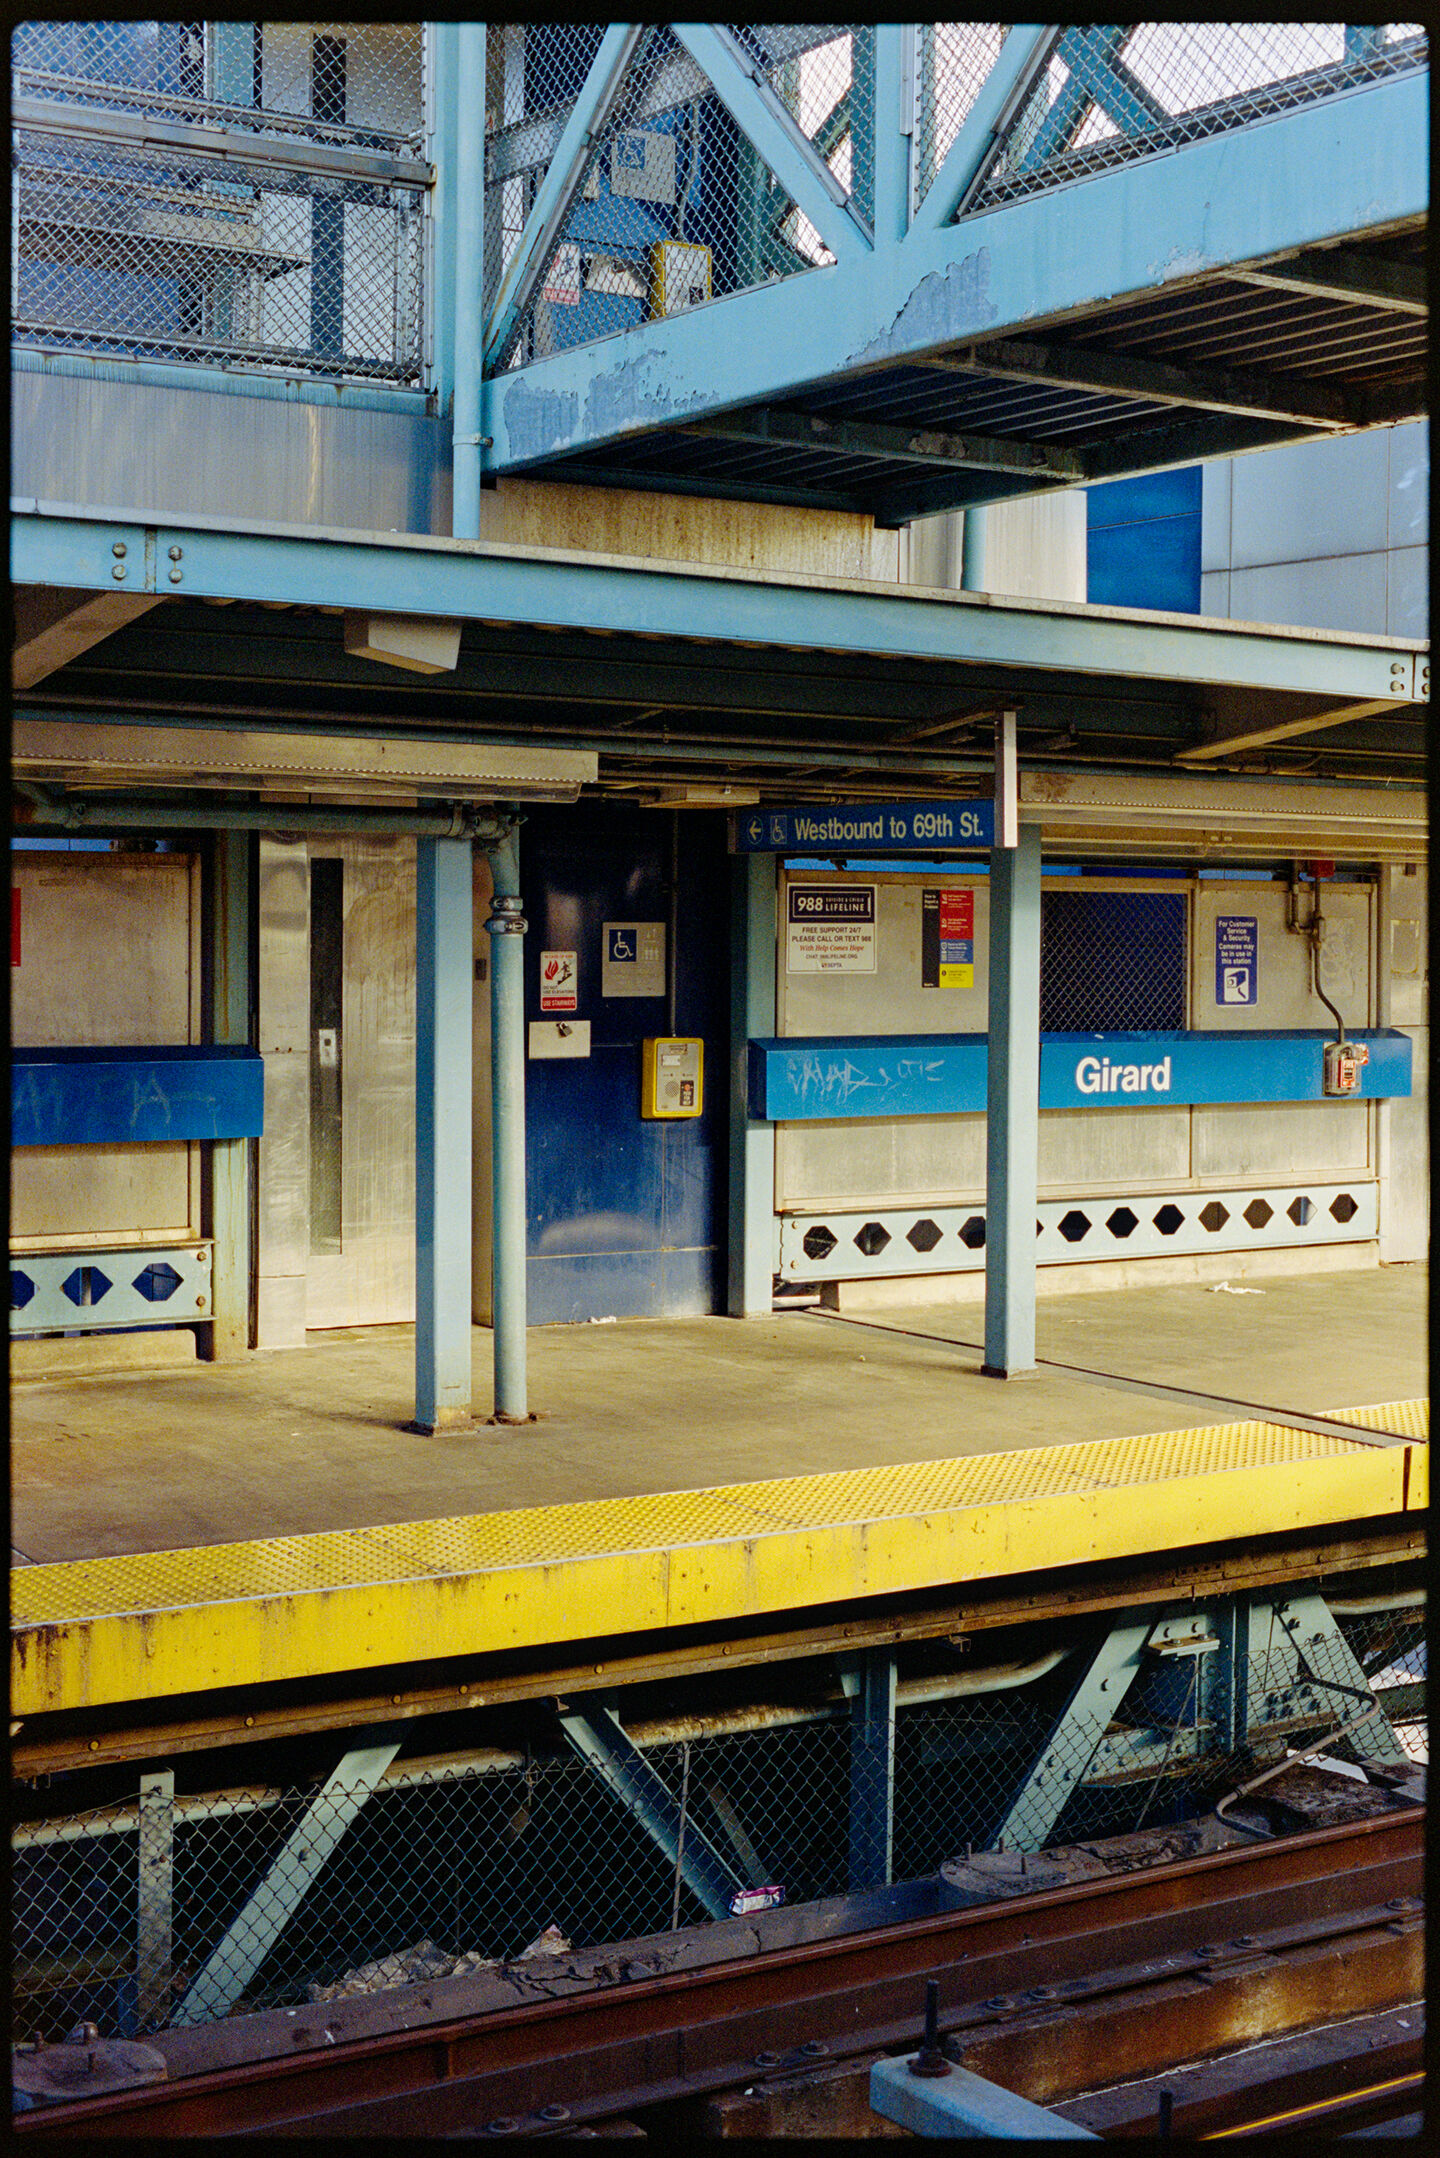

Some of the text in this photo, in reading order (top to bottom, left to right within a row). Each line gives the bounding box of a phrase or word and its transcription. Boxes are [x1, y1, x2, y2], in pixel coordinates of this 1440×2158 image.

[794, 811, 984, 841] Westbound to 69th St.
[797, 897, 823, 912] 988
[825, 903, 865, 912] LIFELINE
[1228, 934, 1250, 942] Security
[815, 944, 828, 953] Help
[849, 944, 865, 952] Hope
[1076, 1056, 1171, 1094] Girard
